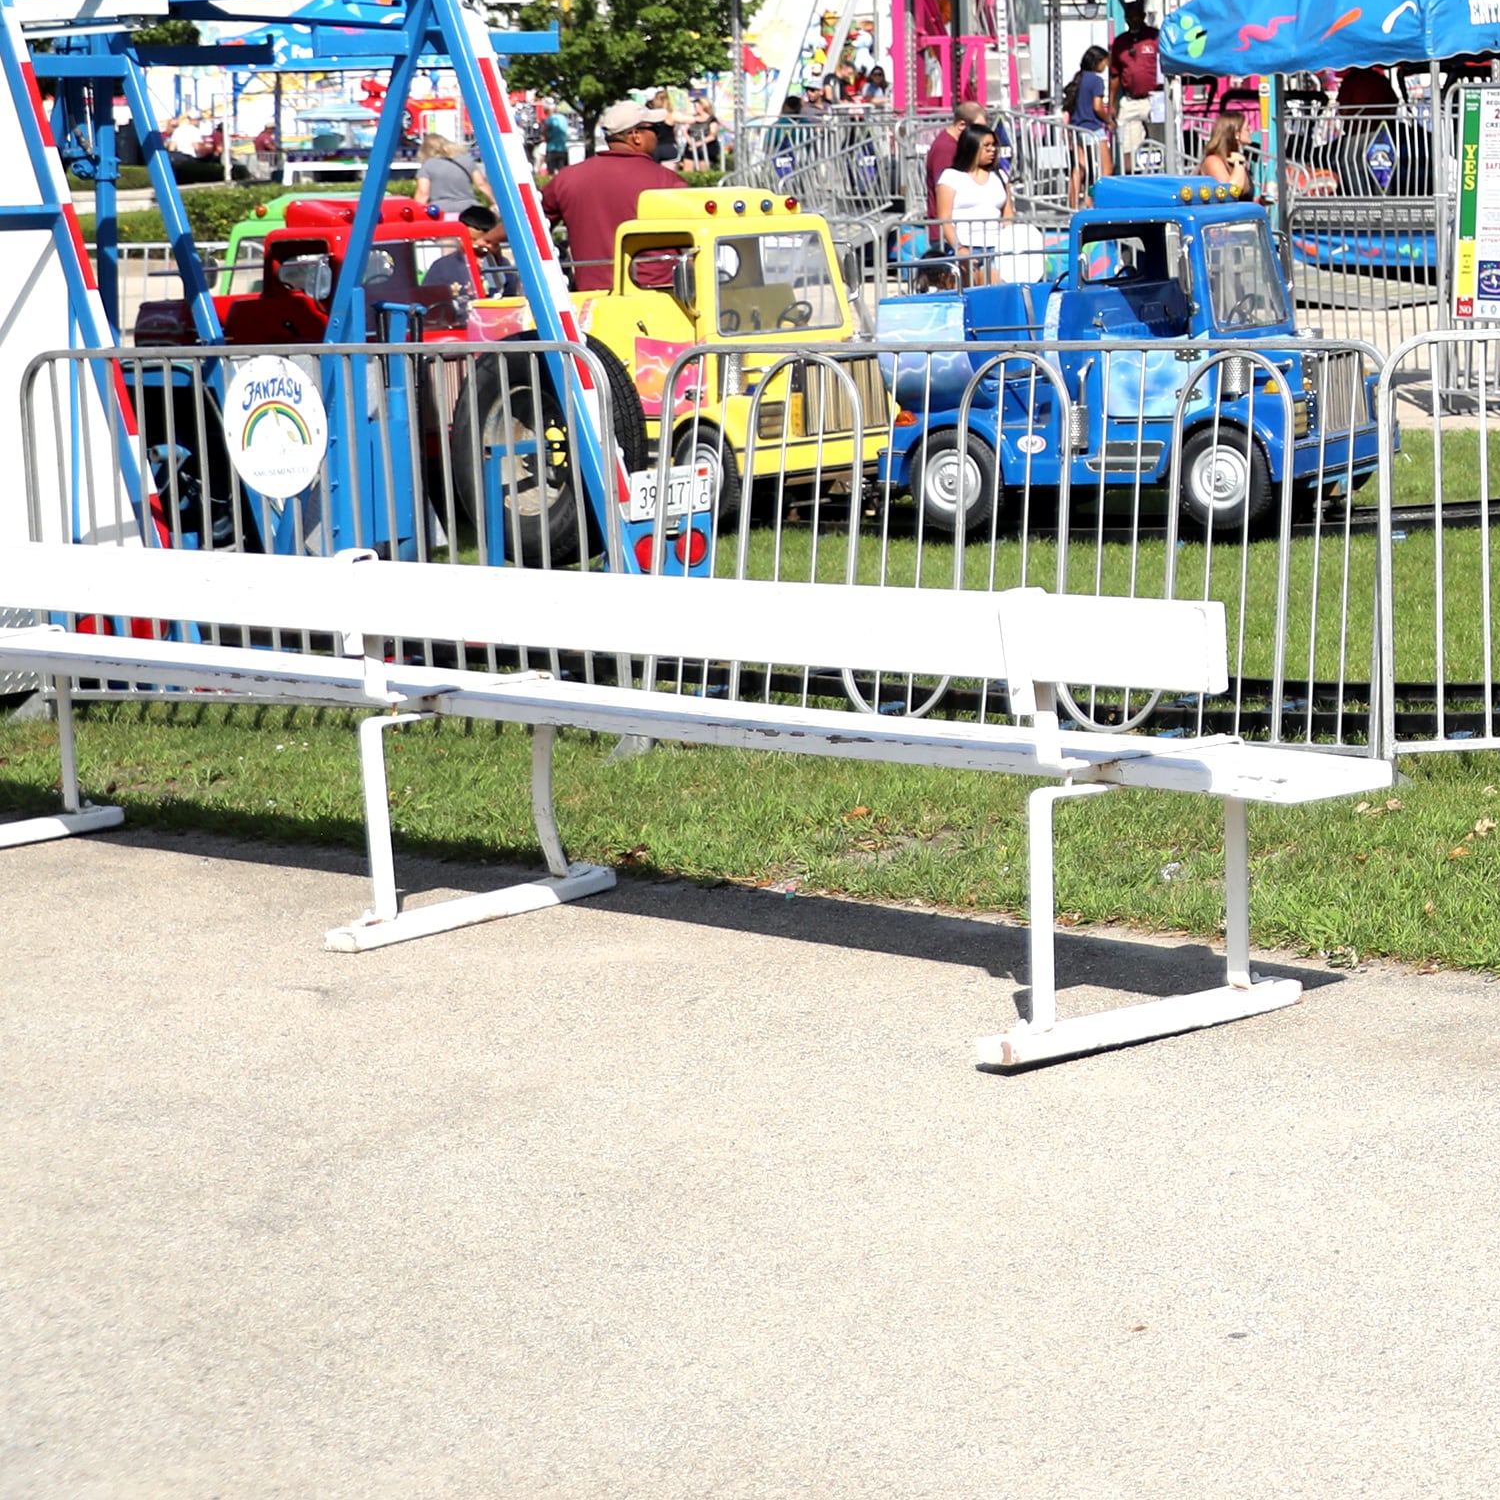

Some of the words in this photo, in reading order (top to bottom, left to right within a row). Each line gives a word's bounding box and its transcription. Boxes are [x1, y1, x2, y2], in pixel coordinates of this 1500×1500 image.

[1464, 144, 1478, 191] YES
[1458, 305, 1472, 315] NO
[242, 377, 302, 411] FANTASY
